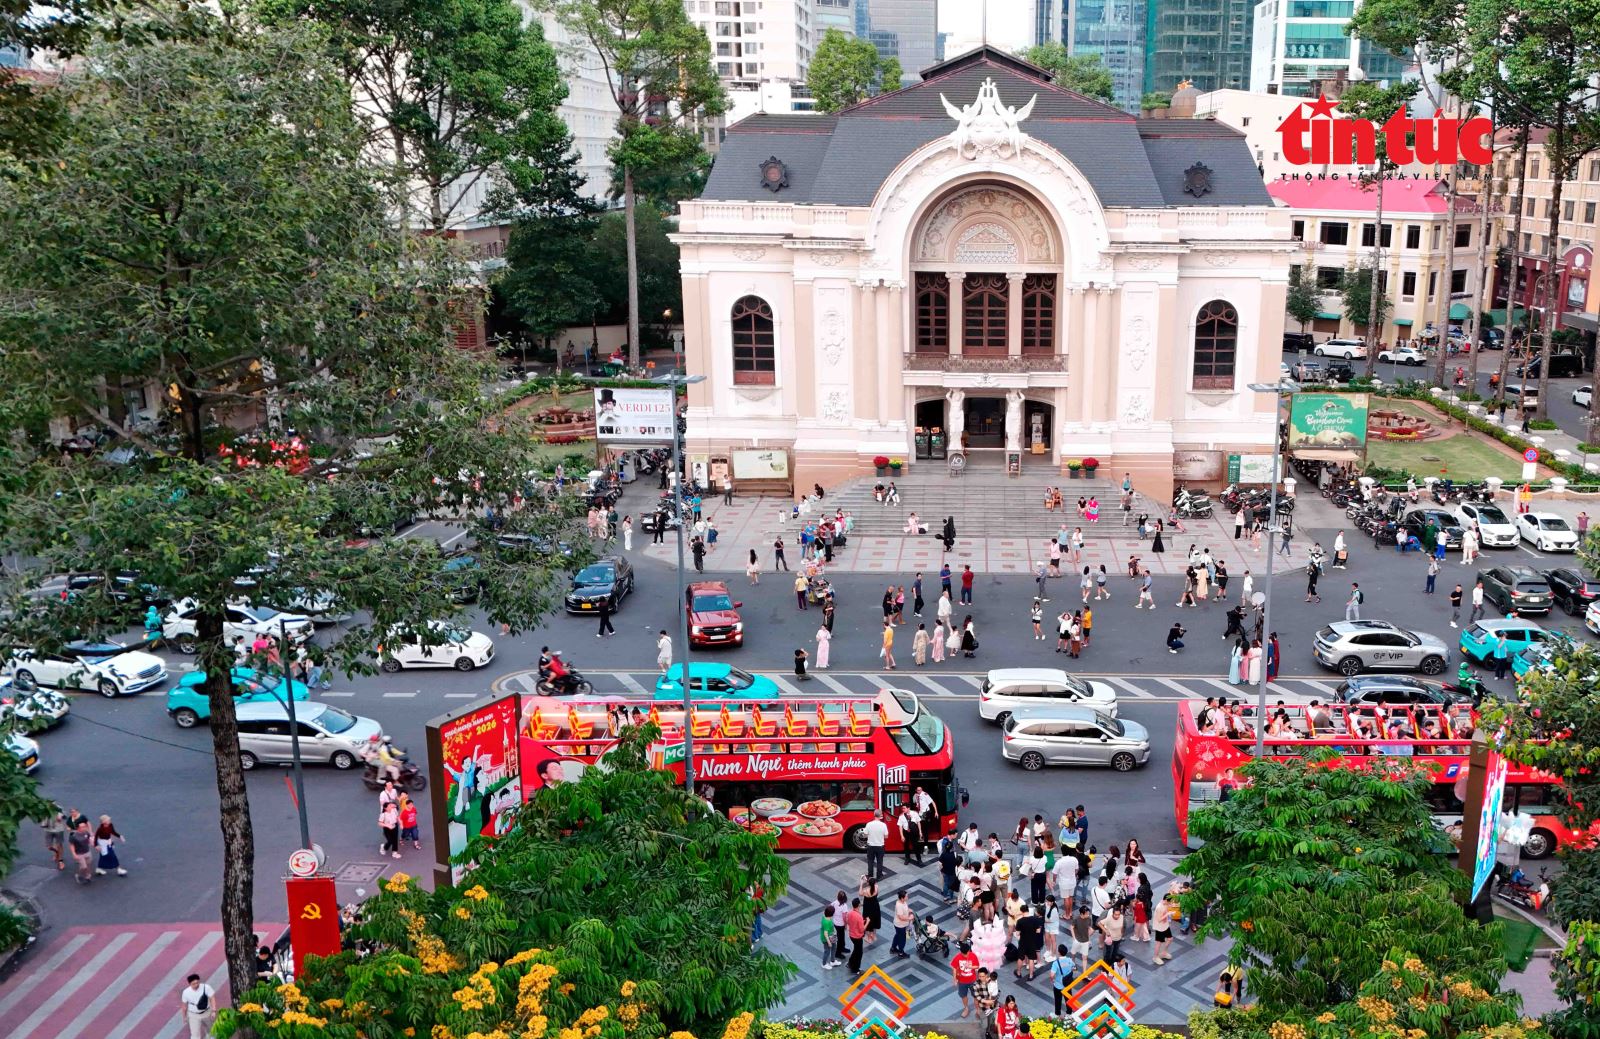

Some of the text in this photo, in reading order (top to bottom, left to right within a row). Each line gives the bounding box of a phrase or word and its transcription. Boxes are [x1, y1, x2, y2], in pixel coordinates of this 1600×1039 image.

[618, 403, 651, 413] VERDI
[1388, 652, 1404, 660] VIP
[476, 719, 497, 736] 2026
[700, 758, 742, 778] Nam
[787, 759, 813, 770] thêm
[814, 756, 840, 771] hạnh
[841, 756, 867, 772] phúc
